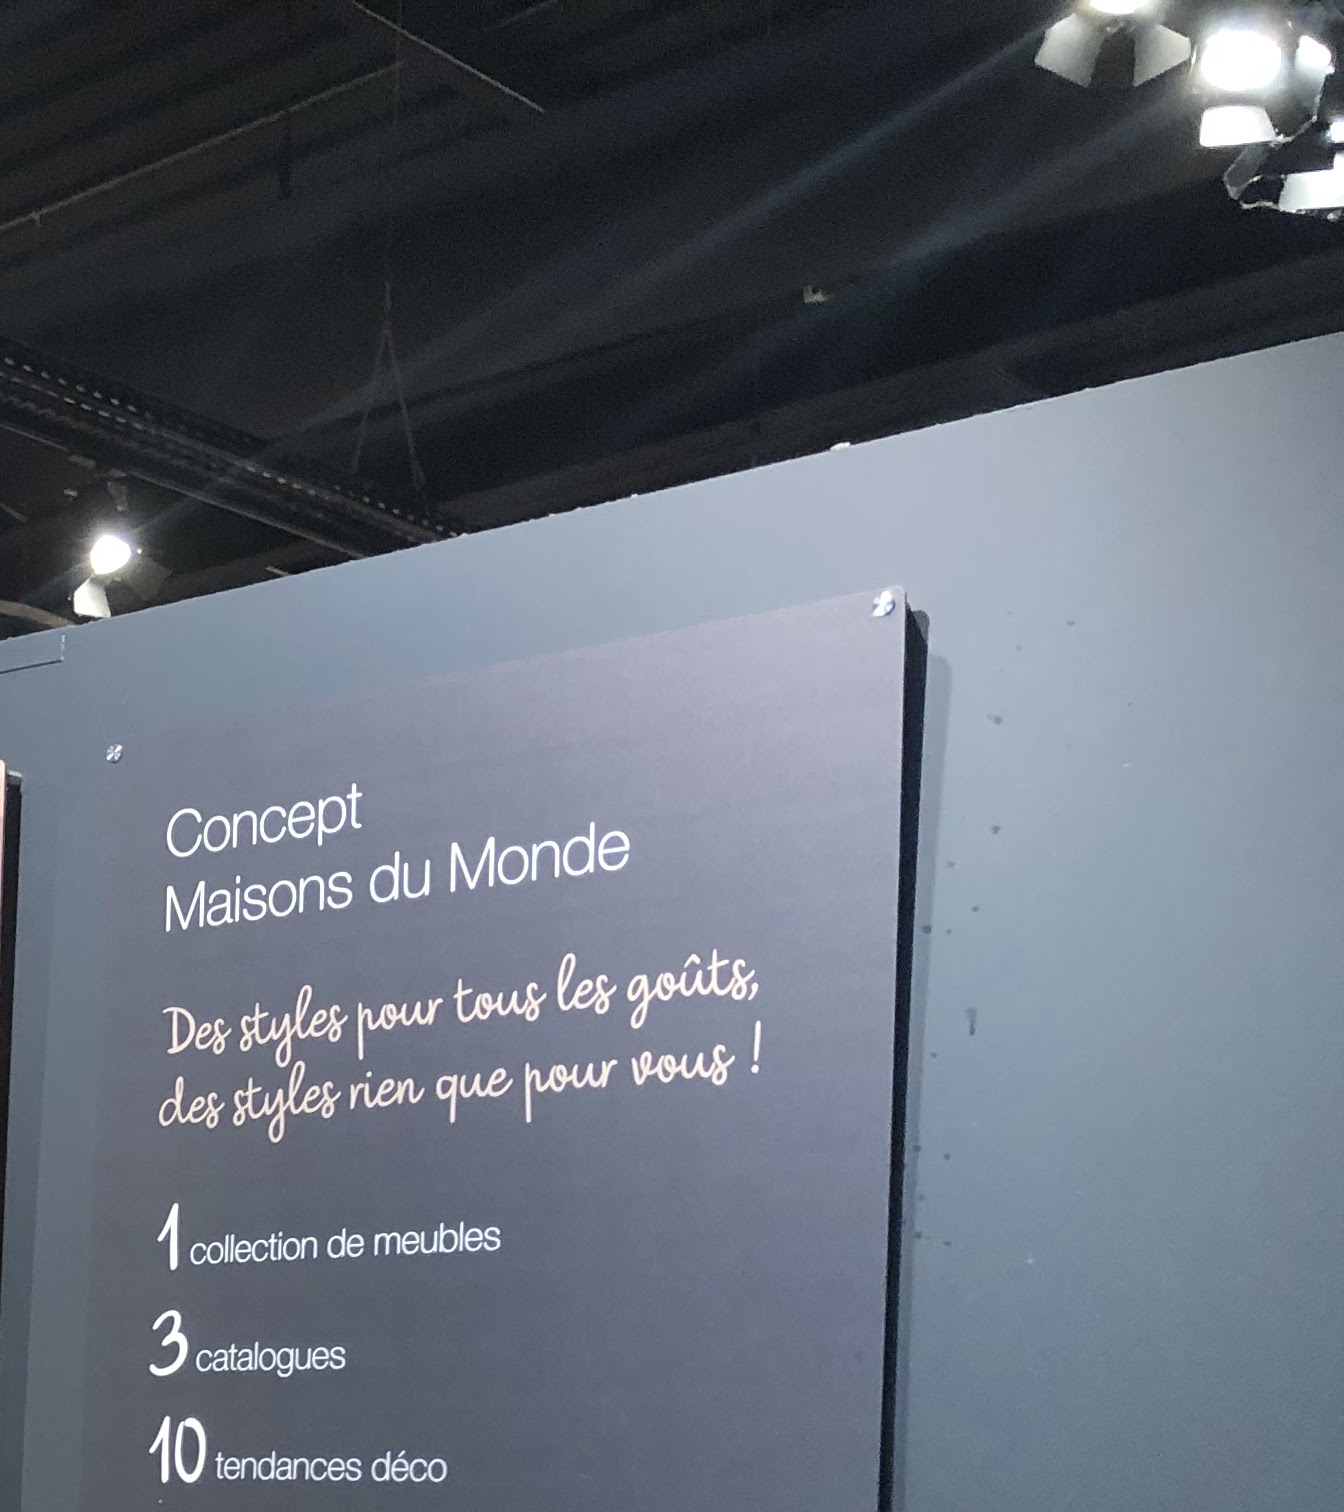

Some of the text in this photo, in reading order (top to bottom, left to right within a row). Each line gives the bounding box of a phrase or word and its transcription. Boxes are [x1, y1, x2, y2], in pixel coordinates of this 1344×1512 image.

[165, 782, 363, 859] Concept
[164, 821, 631, 933] Maisons du Monde
[161, 948, 759, 1068] Des styles pour tous les goûts,
[158, 1020, 762, 1144] des styles rien que pour vous !
[156, 1202, 502, 1271] 1 collection de meubles
[148, 1309, 347, 1378] 3 catalogues
[148, 1415, 448, 1484] 10 tendances déco
